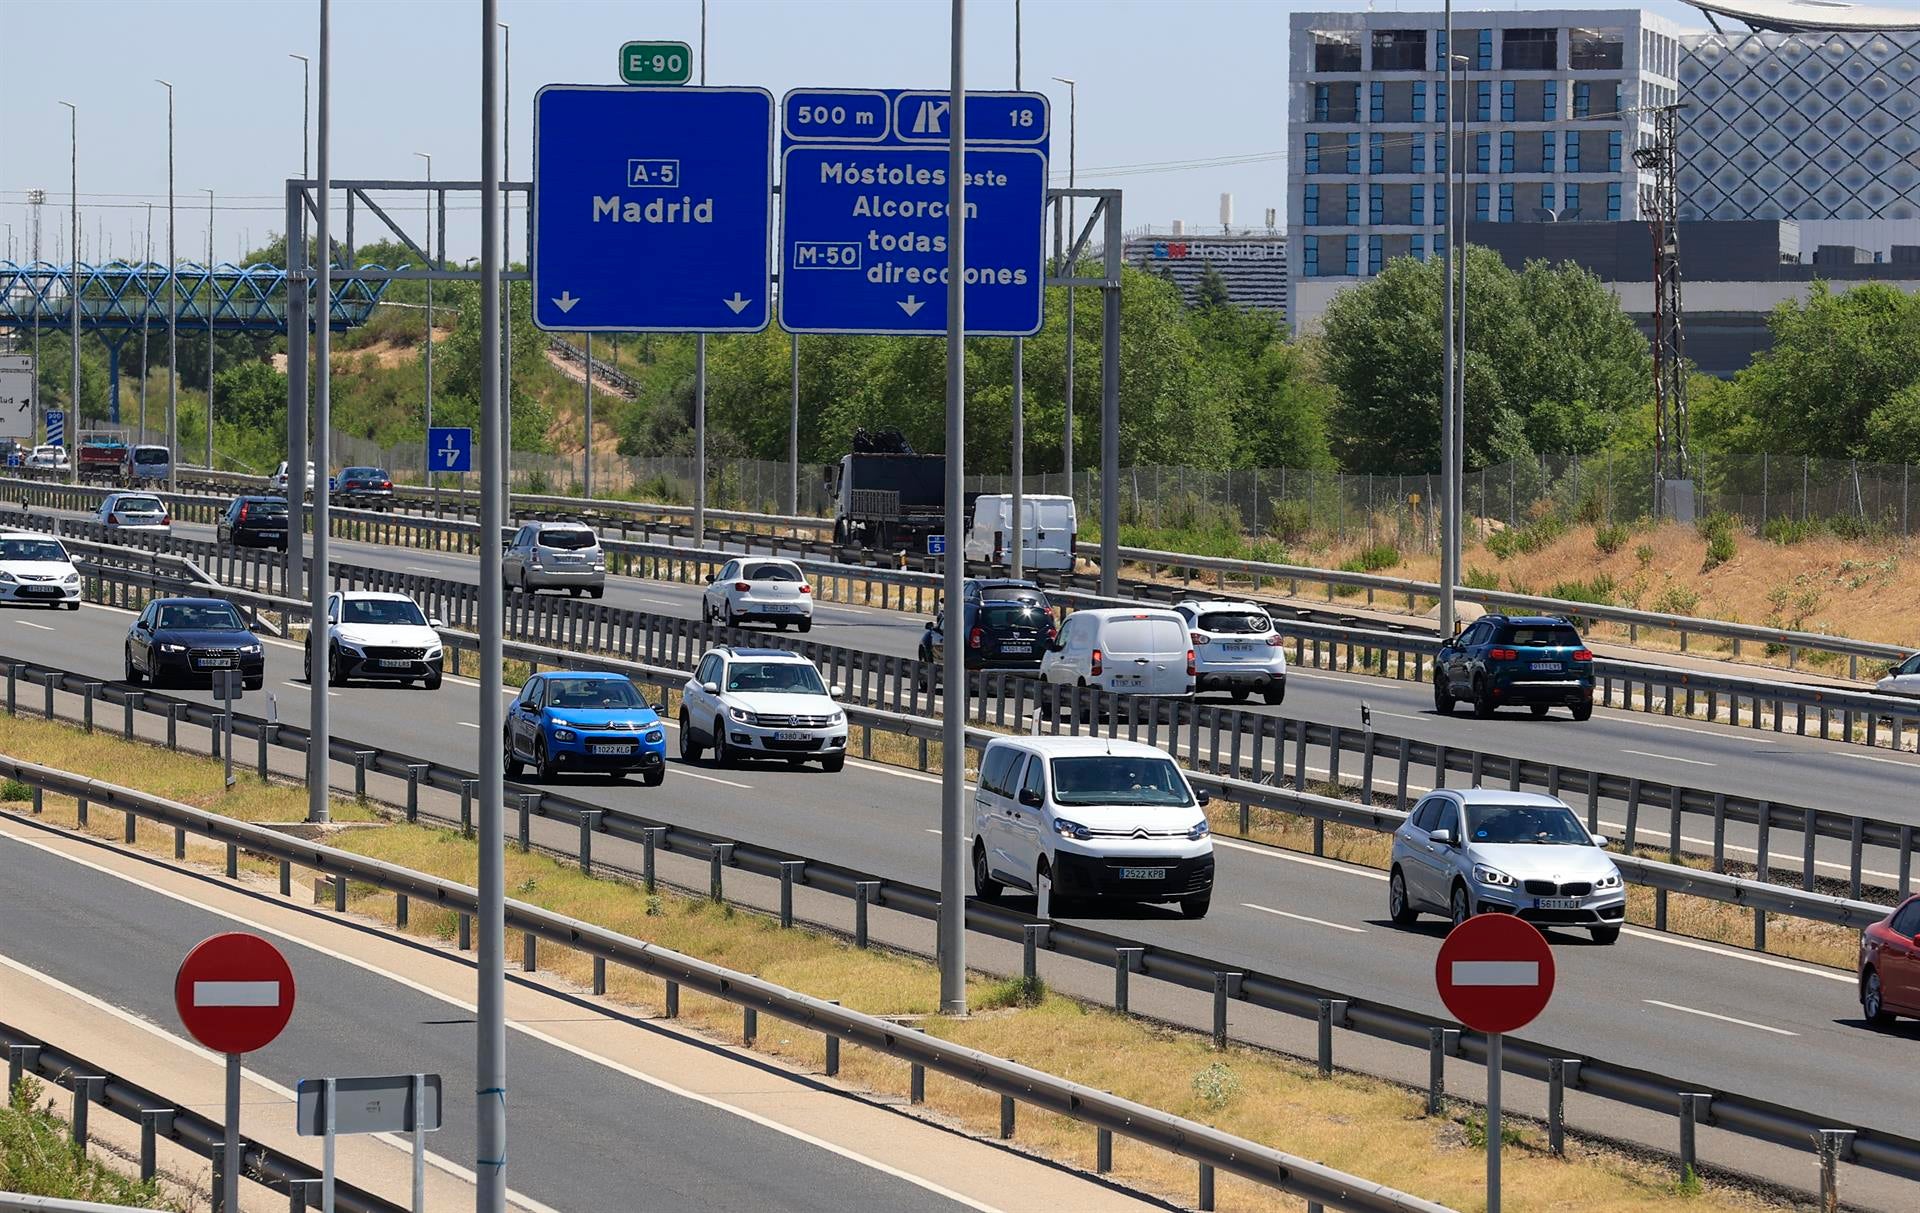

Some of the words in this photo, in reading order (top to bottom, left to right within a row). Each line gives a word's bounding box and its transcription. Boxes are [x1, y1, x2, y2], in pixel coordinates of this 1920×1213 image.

[629, 55, 683, 72] E-90
[798, 106, 846, 125] 500
[856, 111, 874, 125] m
[1009, 110, 1034, 127] 18
[633, 165, 673, 182] A-5
[820, 161, 946, 186] Móstoles
[592, 196, 713, 223] Madrid
[852, 195, 978, 219] Alcorcn
[868, 229, 947, 252] todas
[798, 247, 857, 265] M-50
[867, 262, 1028, 286] direccones
[934, 544, 941, 552] 5
[1126, 870, 1146, 878] 2522
